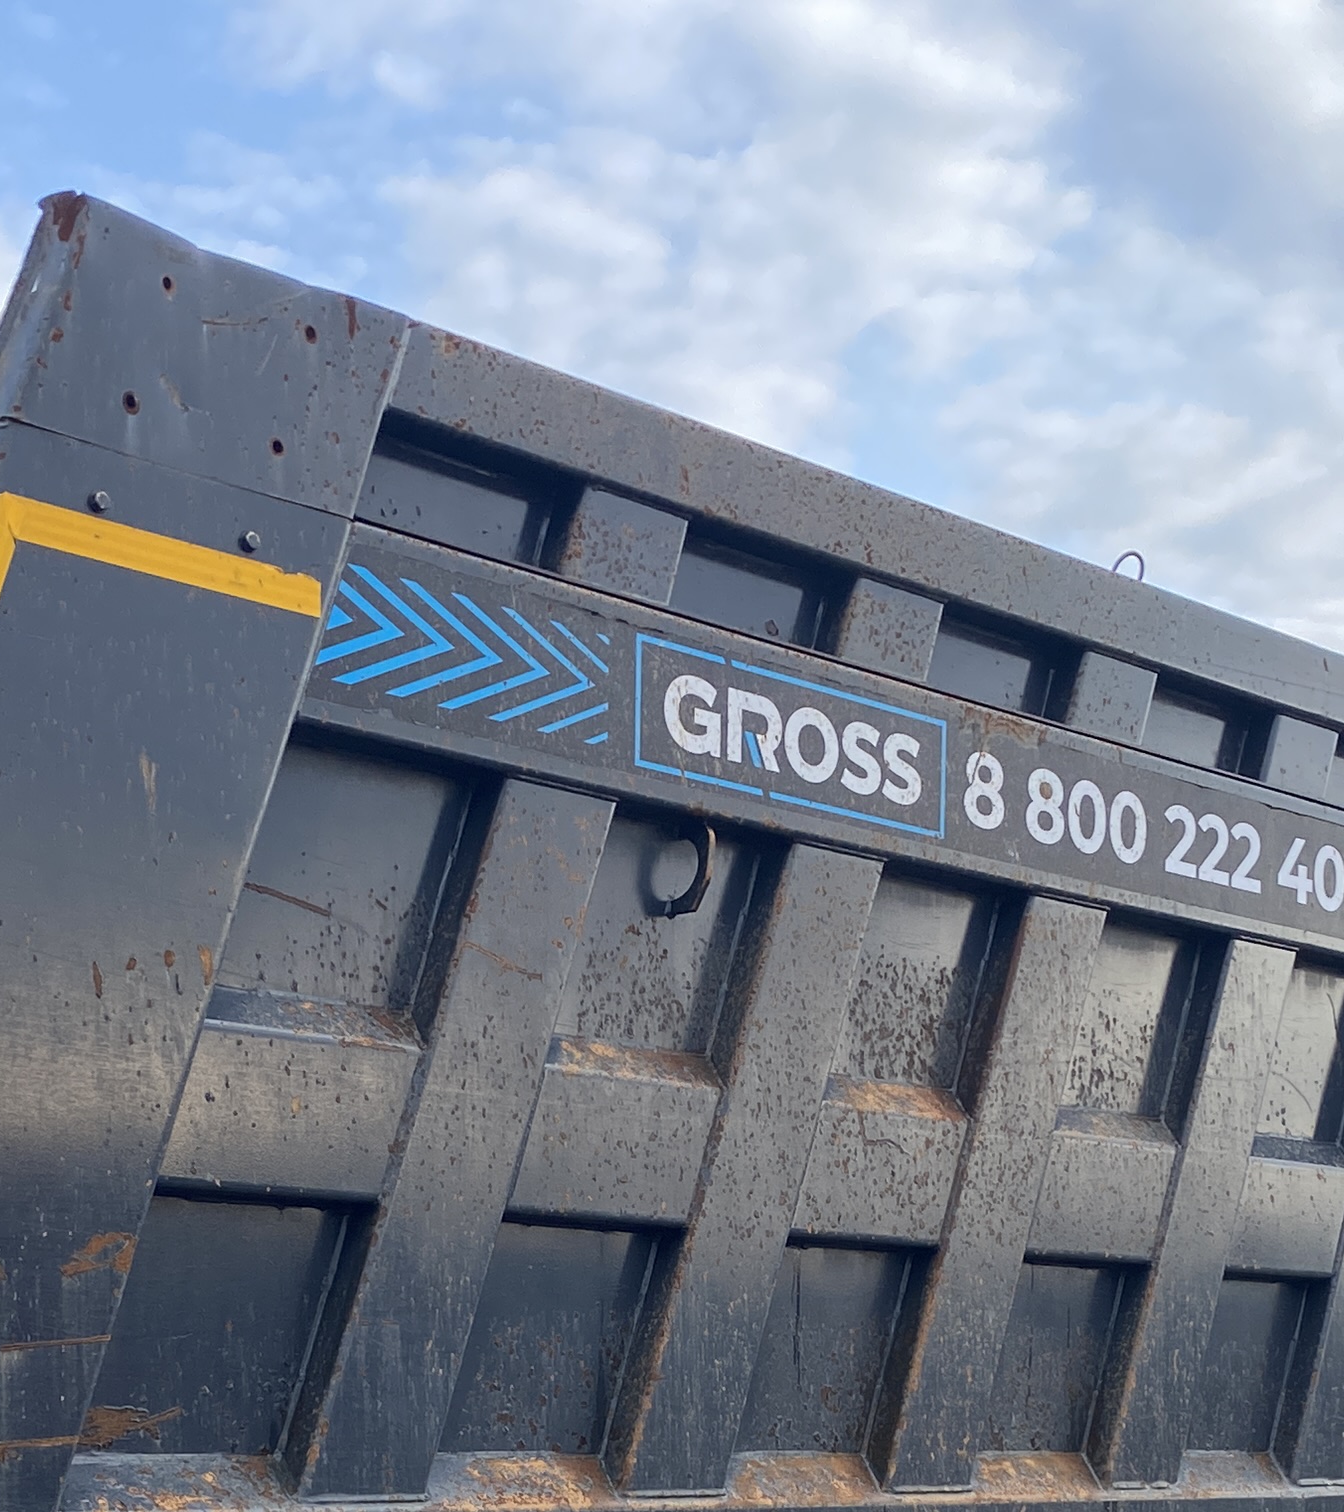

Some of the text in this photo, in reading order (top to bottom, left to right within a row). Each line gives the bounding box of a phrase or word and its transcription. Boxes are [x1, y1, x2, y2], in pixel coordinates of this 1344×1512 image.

[663, 673, 923, 807] GROSS
[962, 750, 1007, 831] 8
[1025, 768, 1148, 865] 800
[1163, 803, 1263, 896] 222
